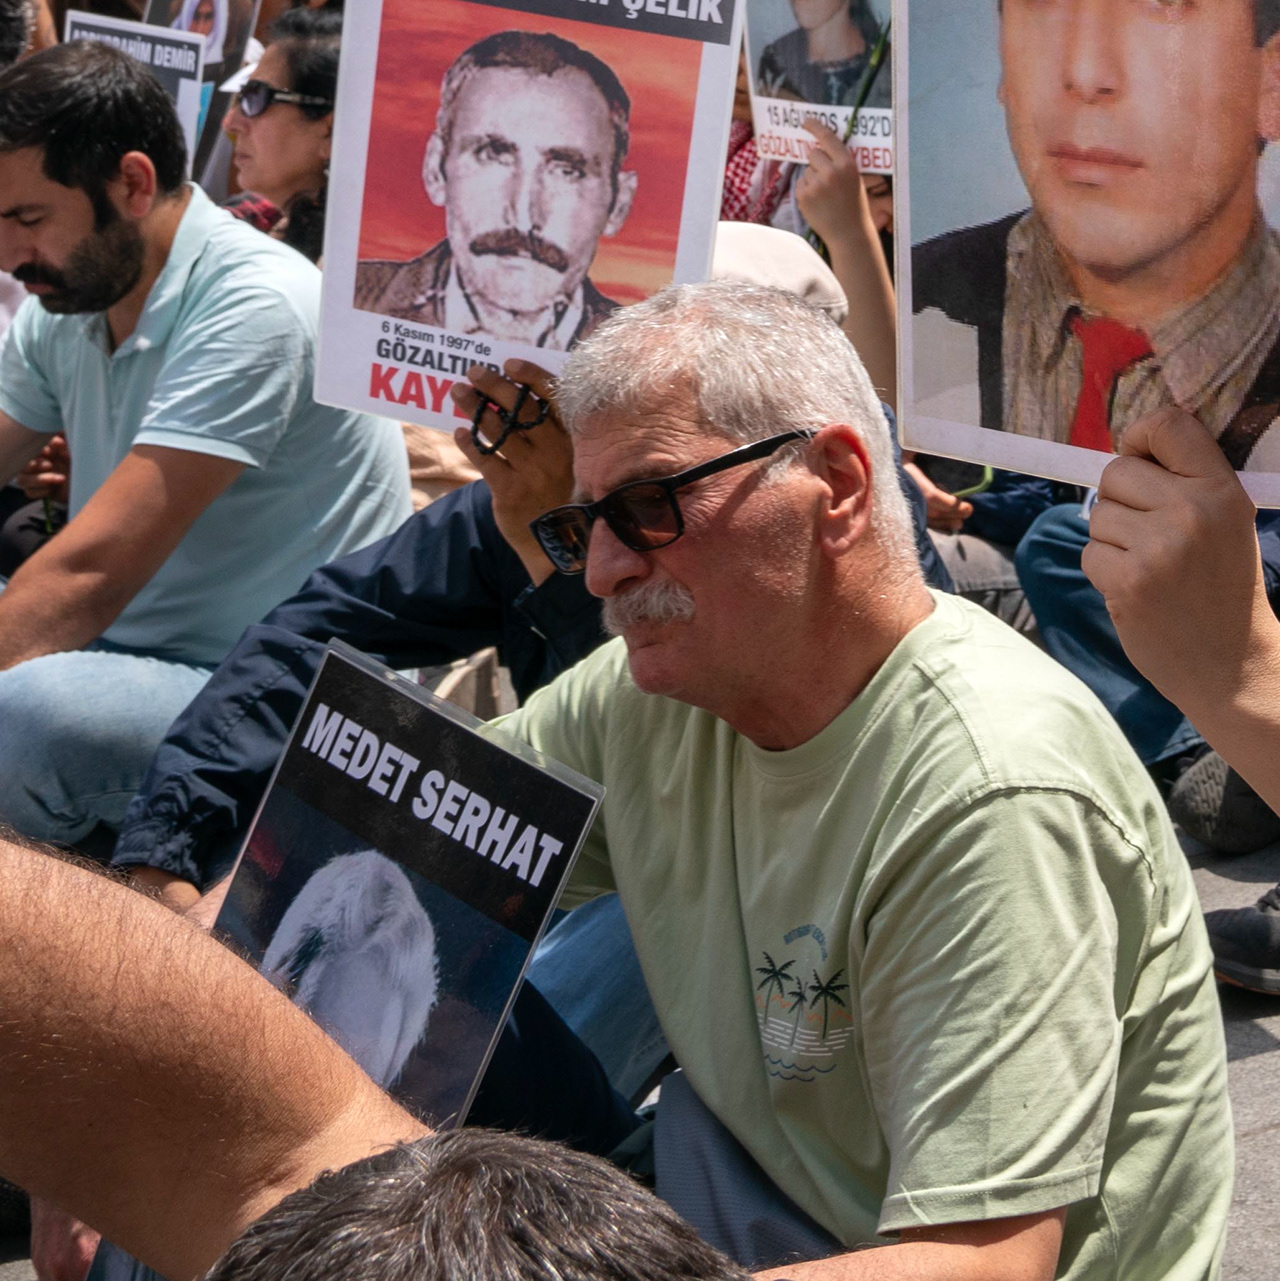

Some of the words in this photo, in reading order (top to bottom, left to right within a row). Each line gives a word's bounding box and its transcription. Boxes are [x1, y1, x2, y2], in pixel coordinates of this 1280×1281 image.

[153, 43, 196, 73] DEMİR
[767, 104, 781, 126] 15
[381, 320, 391, 334] 6
[393, 323, 436, 344] Kasım
[439, 334, 492, 357] 1997'de
[300, 702, 421, 804] MEDET
[412, 768, 564, 888] SERHAT
